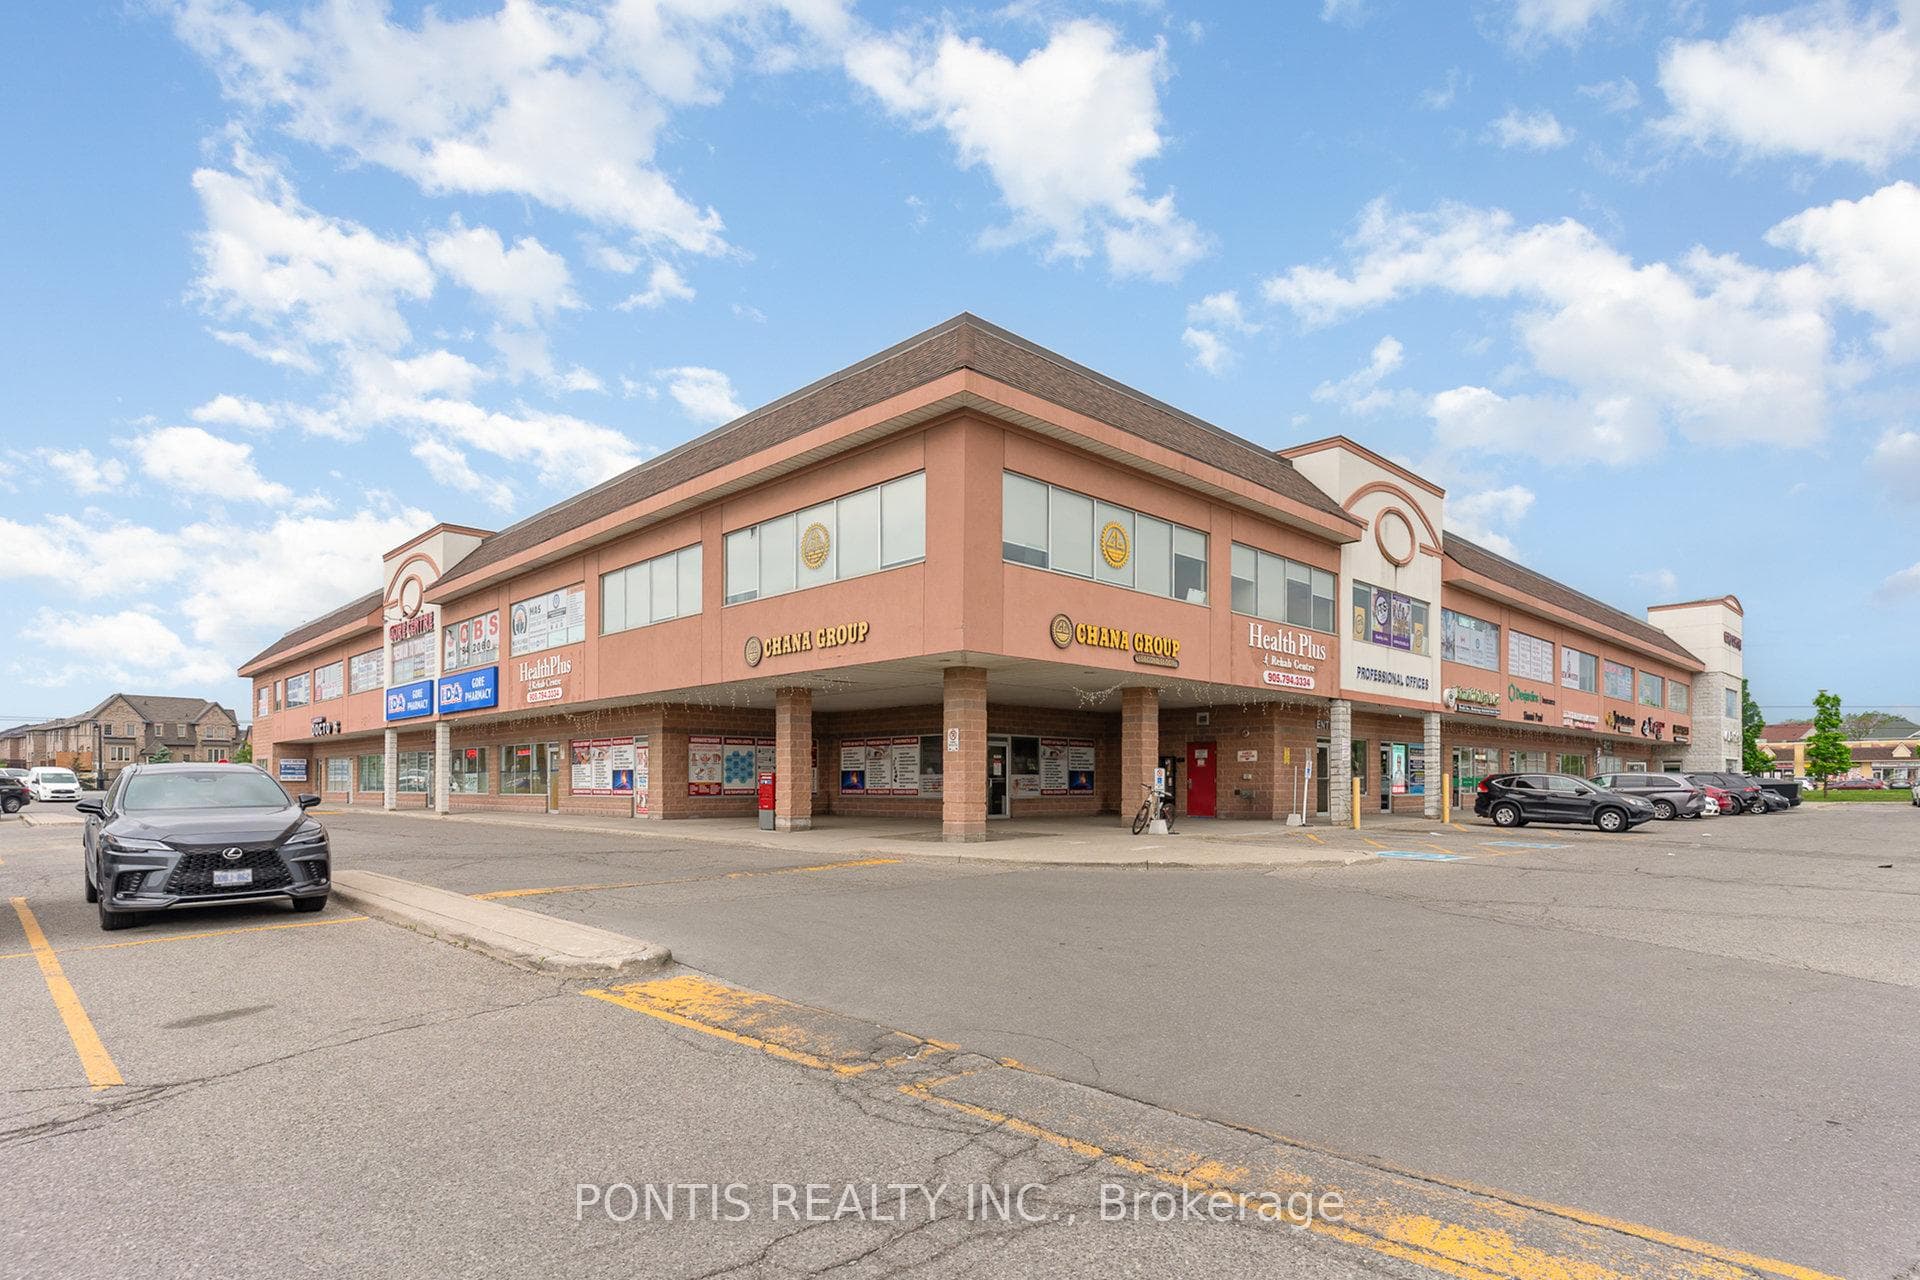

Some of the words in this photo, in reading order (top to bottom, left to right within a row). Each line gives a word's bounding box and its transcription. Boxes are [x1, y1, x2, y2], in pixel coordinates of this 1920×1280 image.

[764, 631, 812, 657] CHANA
[816, 621, 869, 648] GROUP
[1076, 623, 1129, 651] CHANA
[1134, 632, 1180, 657] GROUP
[1248, 622, 1296, 655] Health
[1298, 633, 1326, 660] Plus
[1271, 656, 1292, 668] Rehab
[1294, 659, 1315, 673] Centre
[471, 676, 485, 688] GORE
[1356, 666, 1404, 686] PROFESSIONAL
[1405, 675, 1430, 690] OFFICES
[464, 688, 492, 702] PHARMACY
